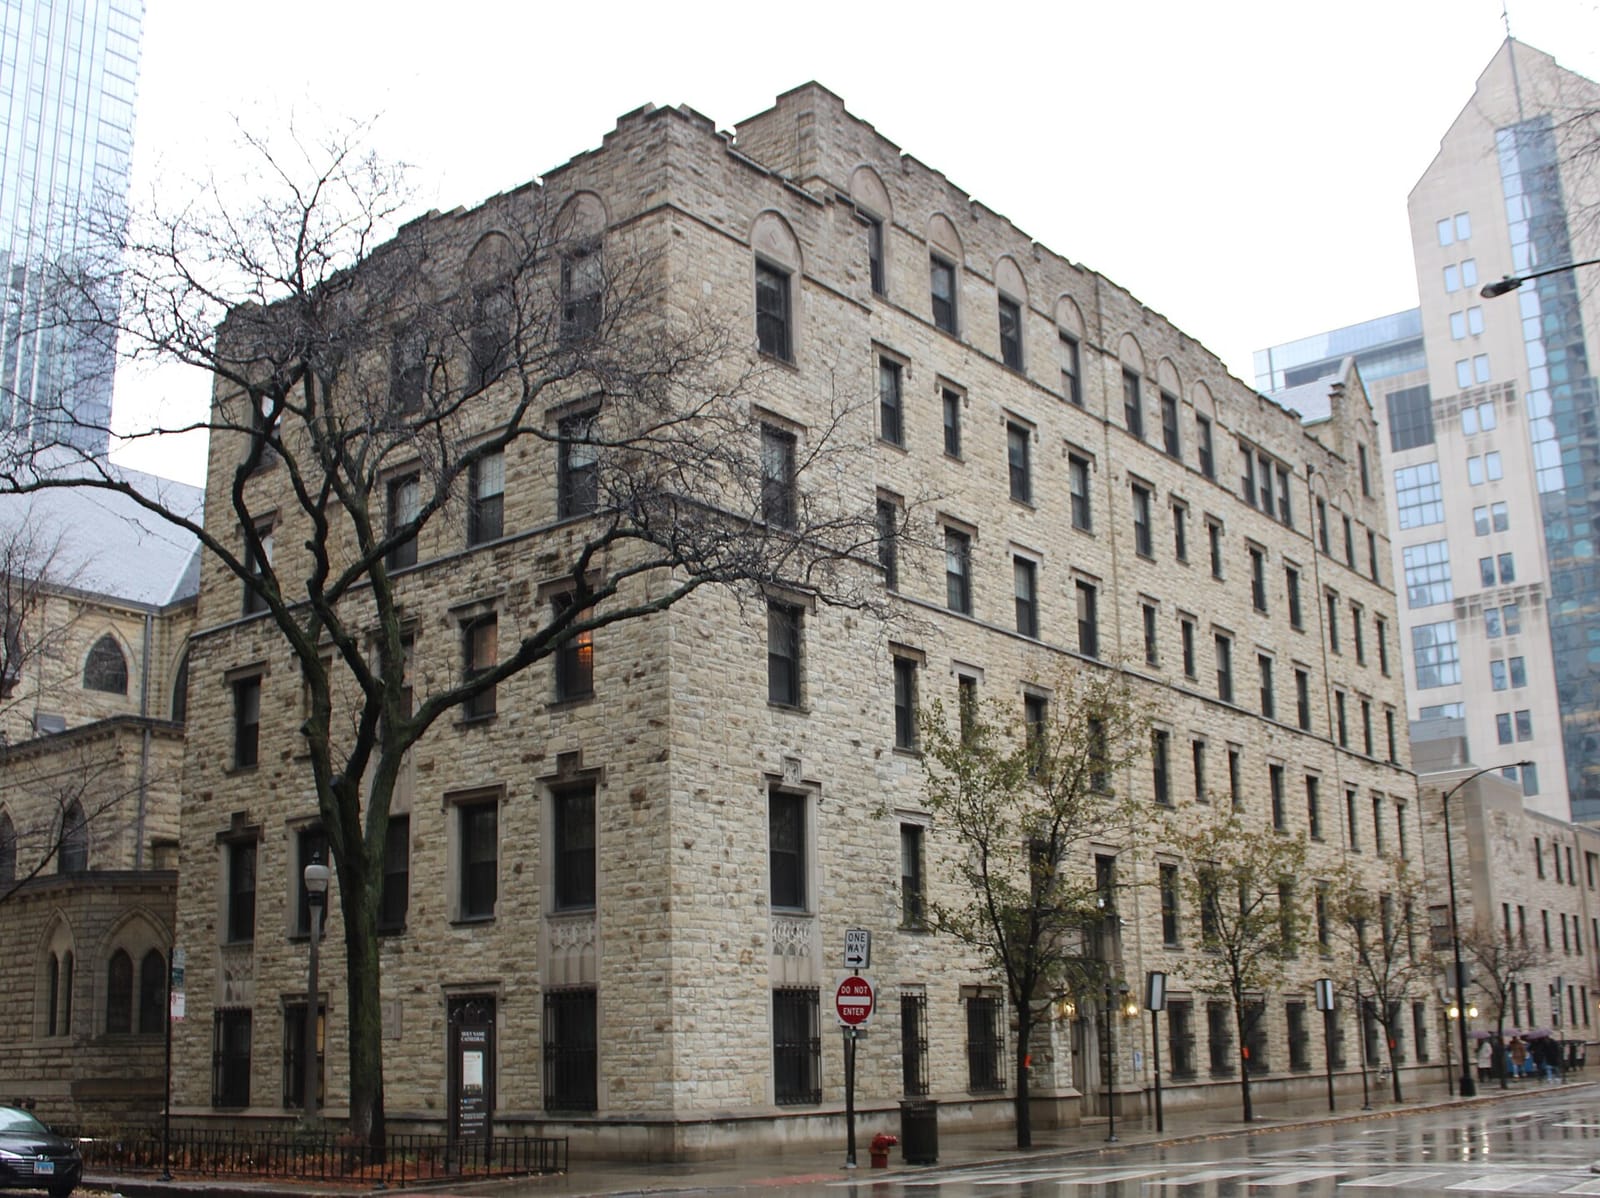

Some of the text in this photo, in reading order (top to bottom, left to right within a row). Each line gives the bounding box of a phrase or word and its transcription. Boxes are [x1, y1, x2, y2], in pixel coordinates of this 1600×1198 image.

[848, 933, 865, 942] ONE
[847, 944, 866, 953] WAY
[843, 1008, 865, 1016] ENTER
